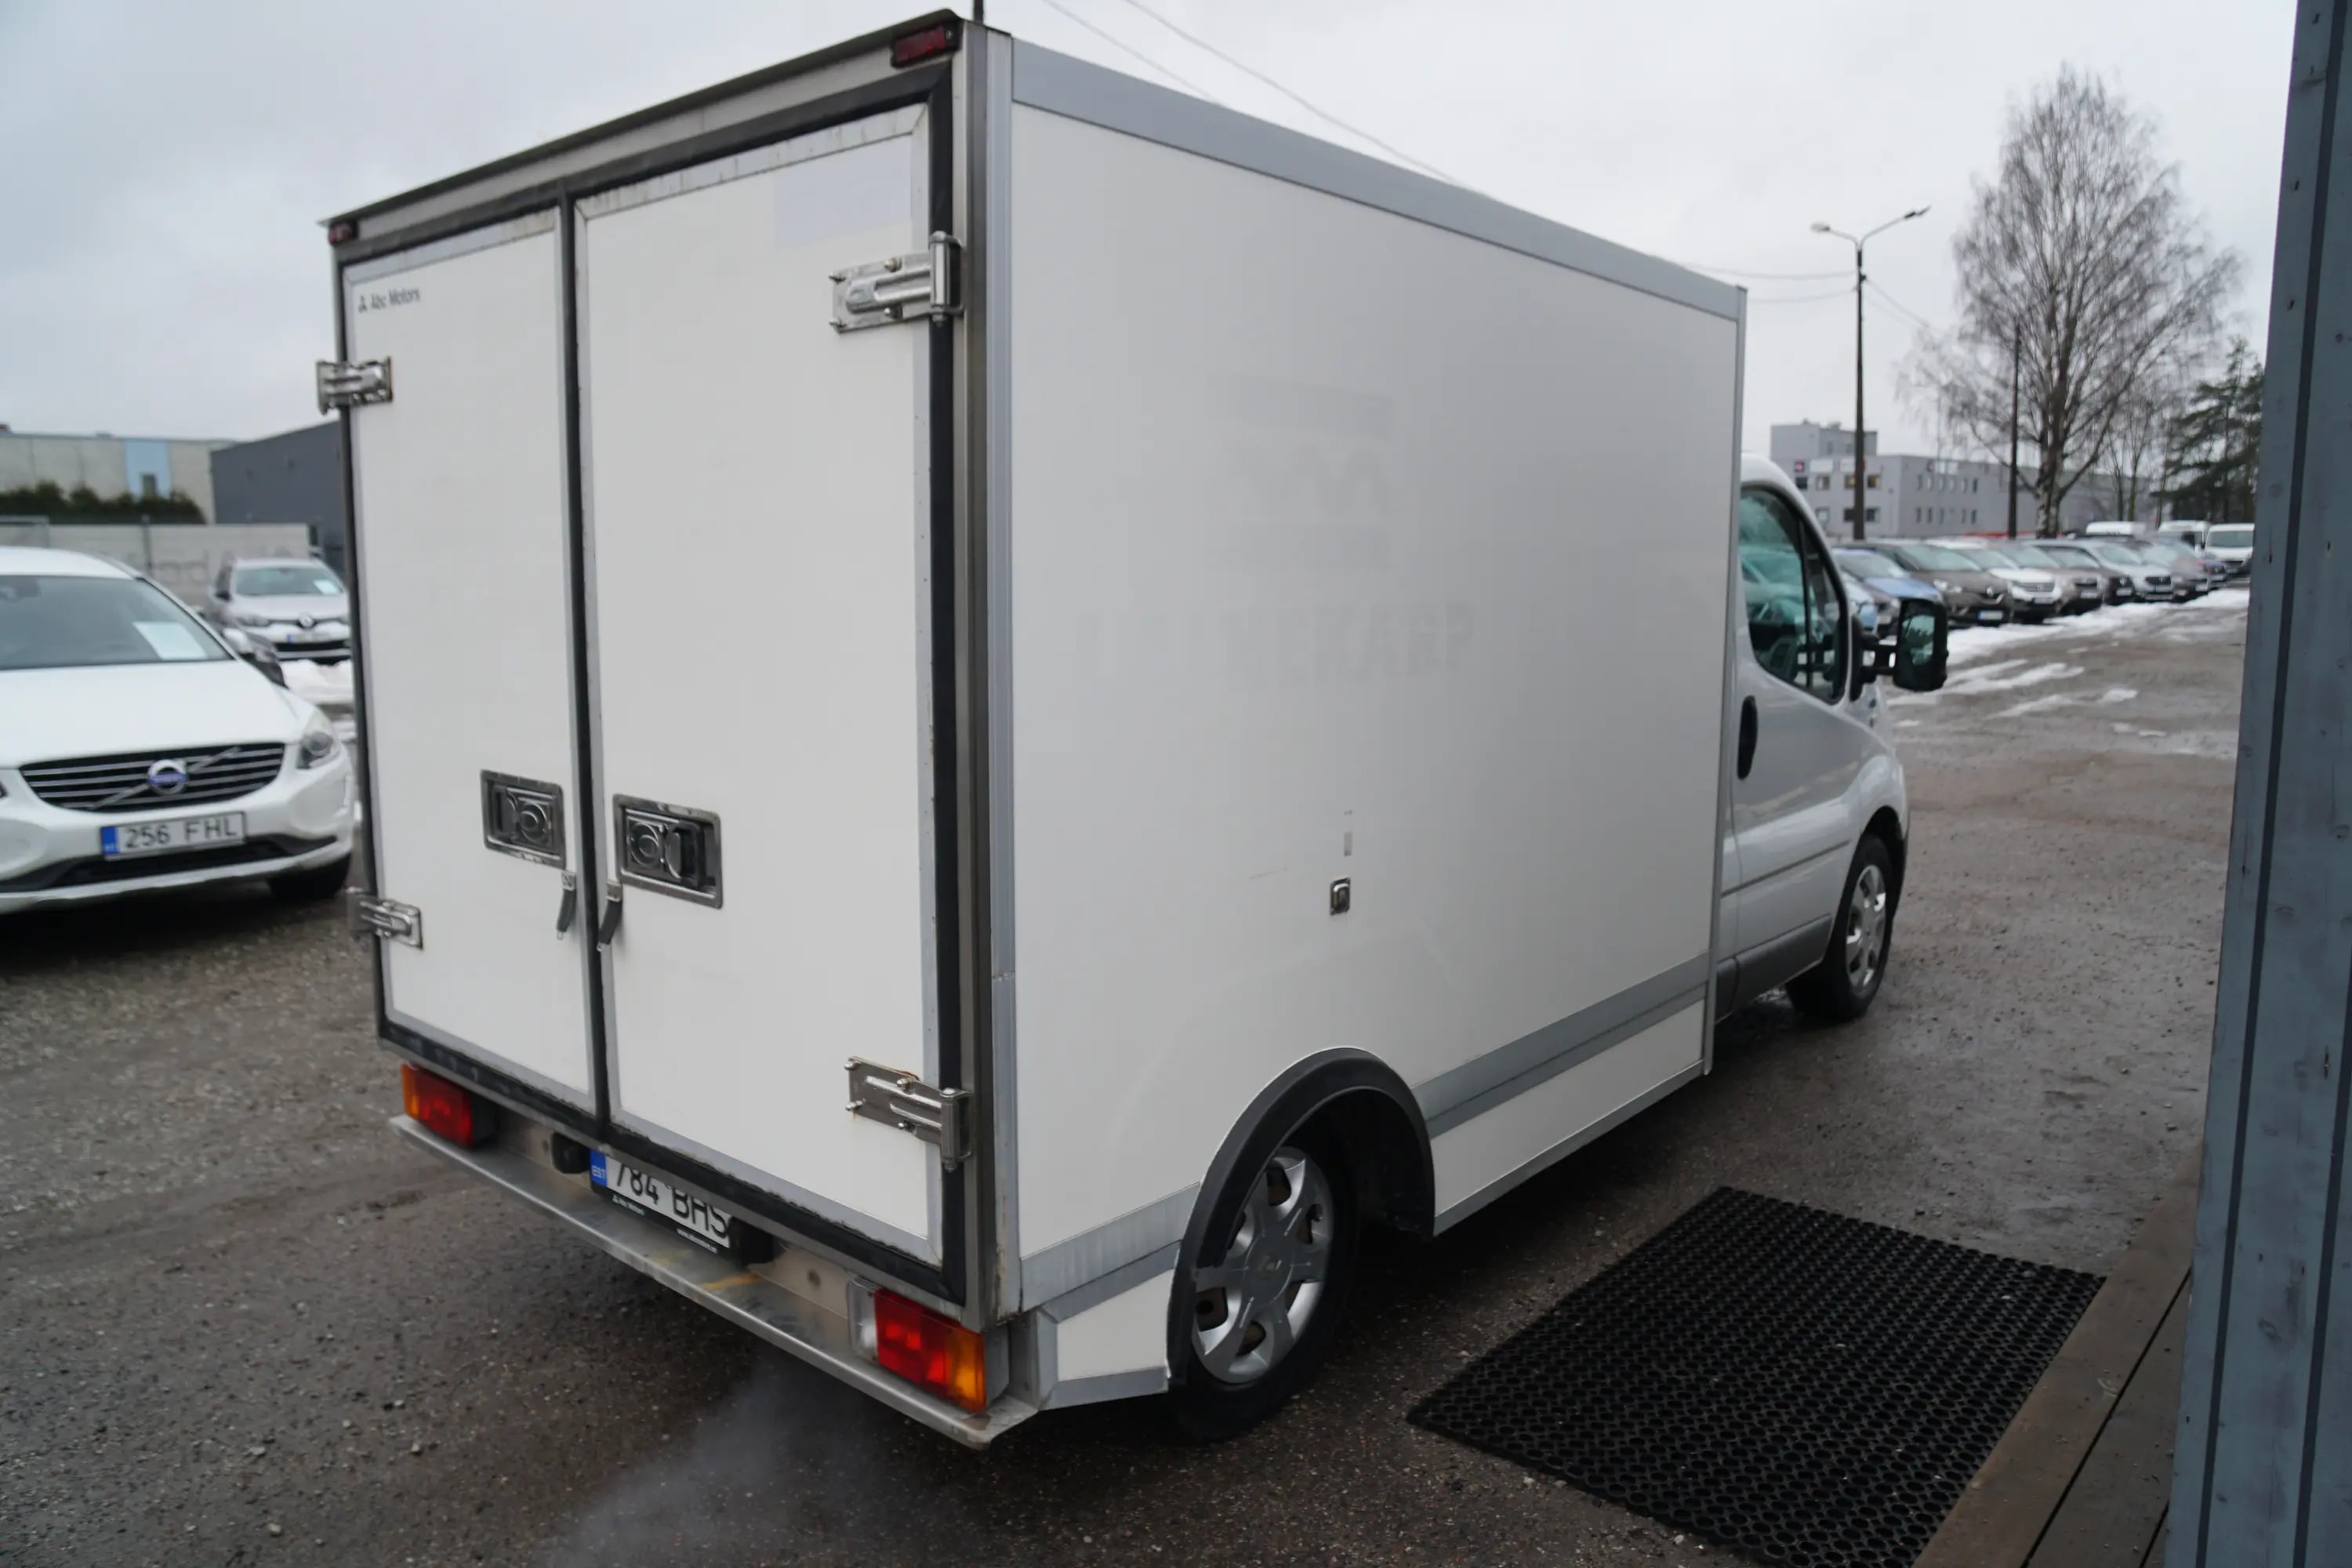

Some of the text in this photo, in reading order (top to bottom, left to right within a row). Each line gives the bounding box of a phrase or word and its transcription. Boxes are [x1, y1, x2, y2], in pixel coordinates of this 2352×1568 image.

[388, 288, 421, 306] Motors
[125, 818, 237, 849] 256 FHL
[591, 1164, 607, 1180] EST
[616, 1163, 728, 1239] 784 BHS
